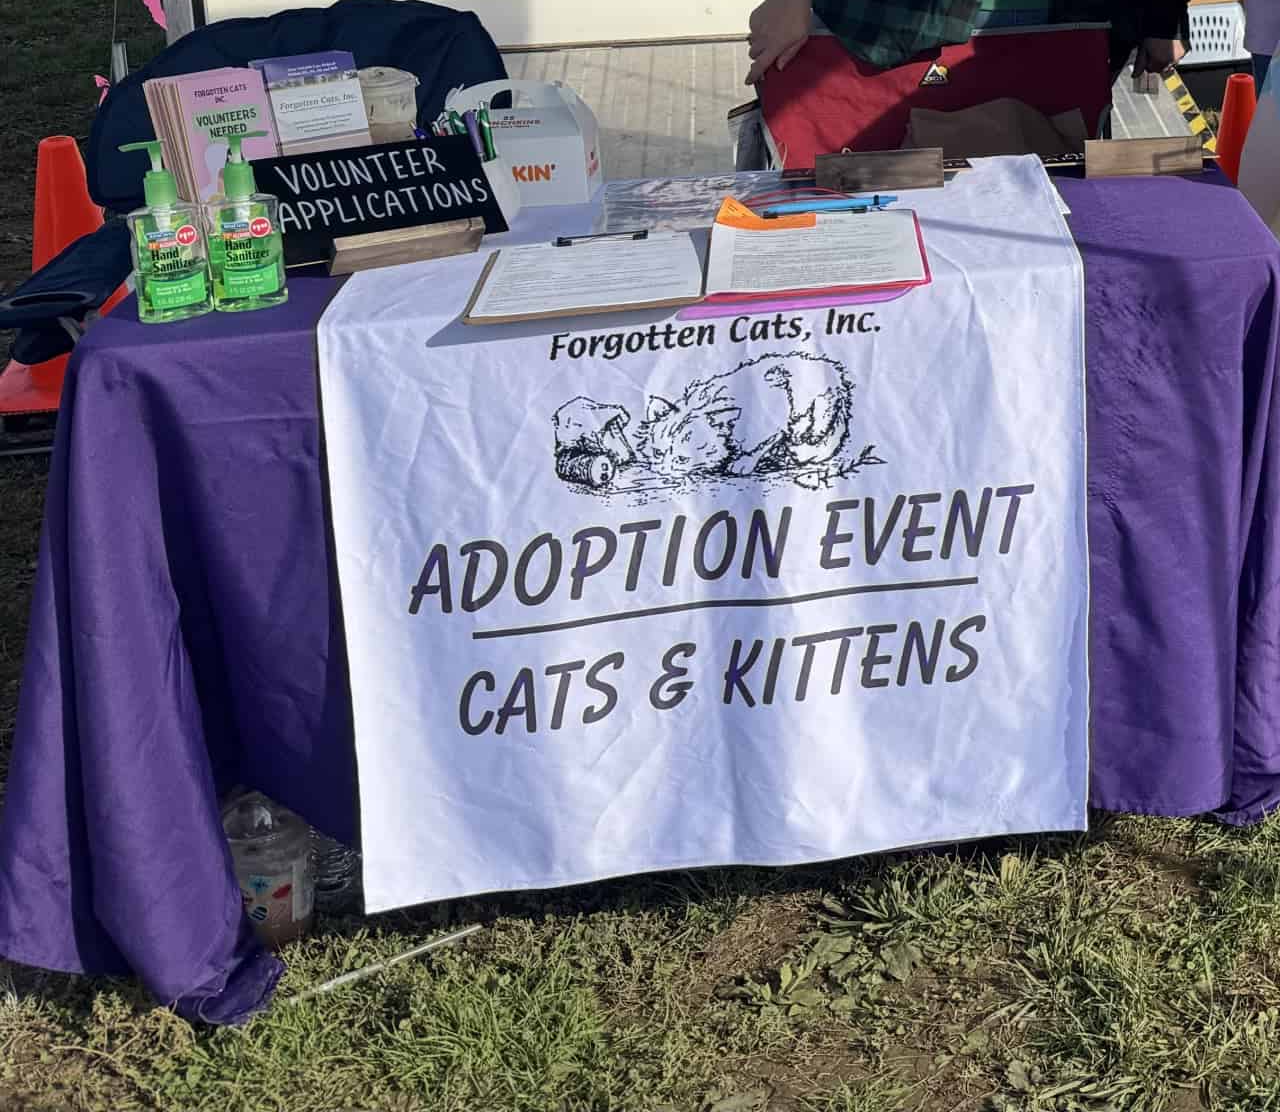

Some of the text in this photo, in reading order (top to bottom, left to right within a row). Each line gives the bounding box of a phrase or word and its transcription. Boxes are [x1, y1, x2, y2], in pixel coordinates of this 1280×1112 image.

[194, 83, 248, 98] FORGOTTEN CATS
[196, 107, 258, 128] VOLUNTEERS
[209, 122, 248, 139] NEEDED
[273, 146, 447, 196] VOLUNTEER
[278, 177, 489, 234] APPLICATIONS
[151, 246, 180, 261] Hand
[225, 239, 252, 251] Hand
[225, 248, 270, 263] Sanitizer
[549, 308, 882, 361] Forgotten Cats, Inc.
[407, 483, 1035, 616] ADOPTION EVENT
[458, 614, 987, 736] CATS & KITTENS
